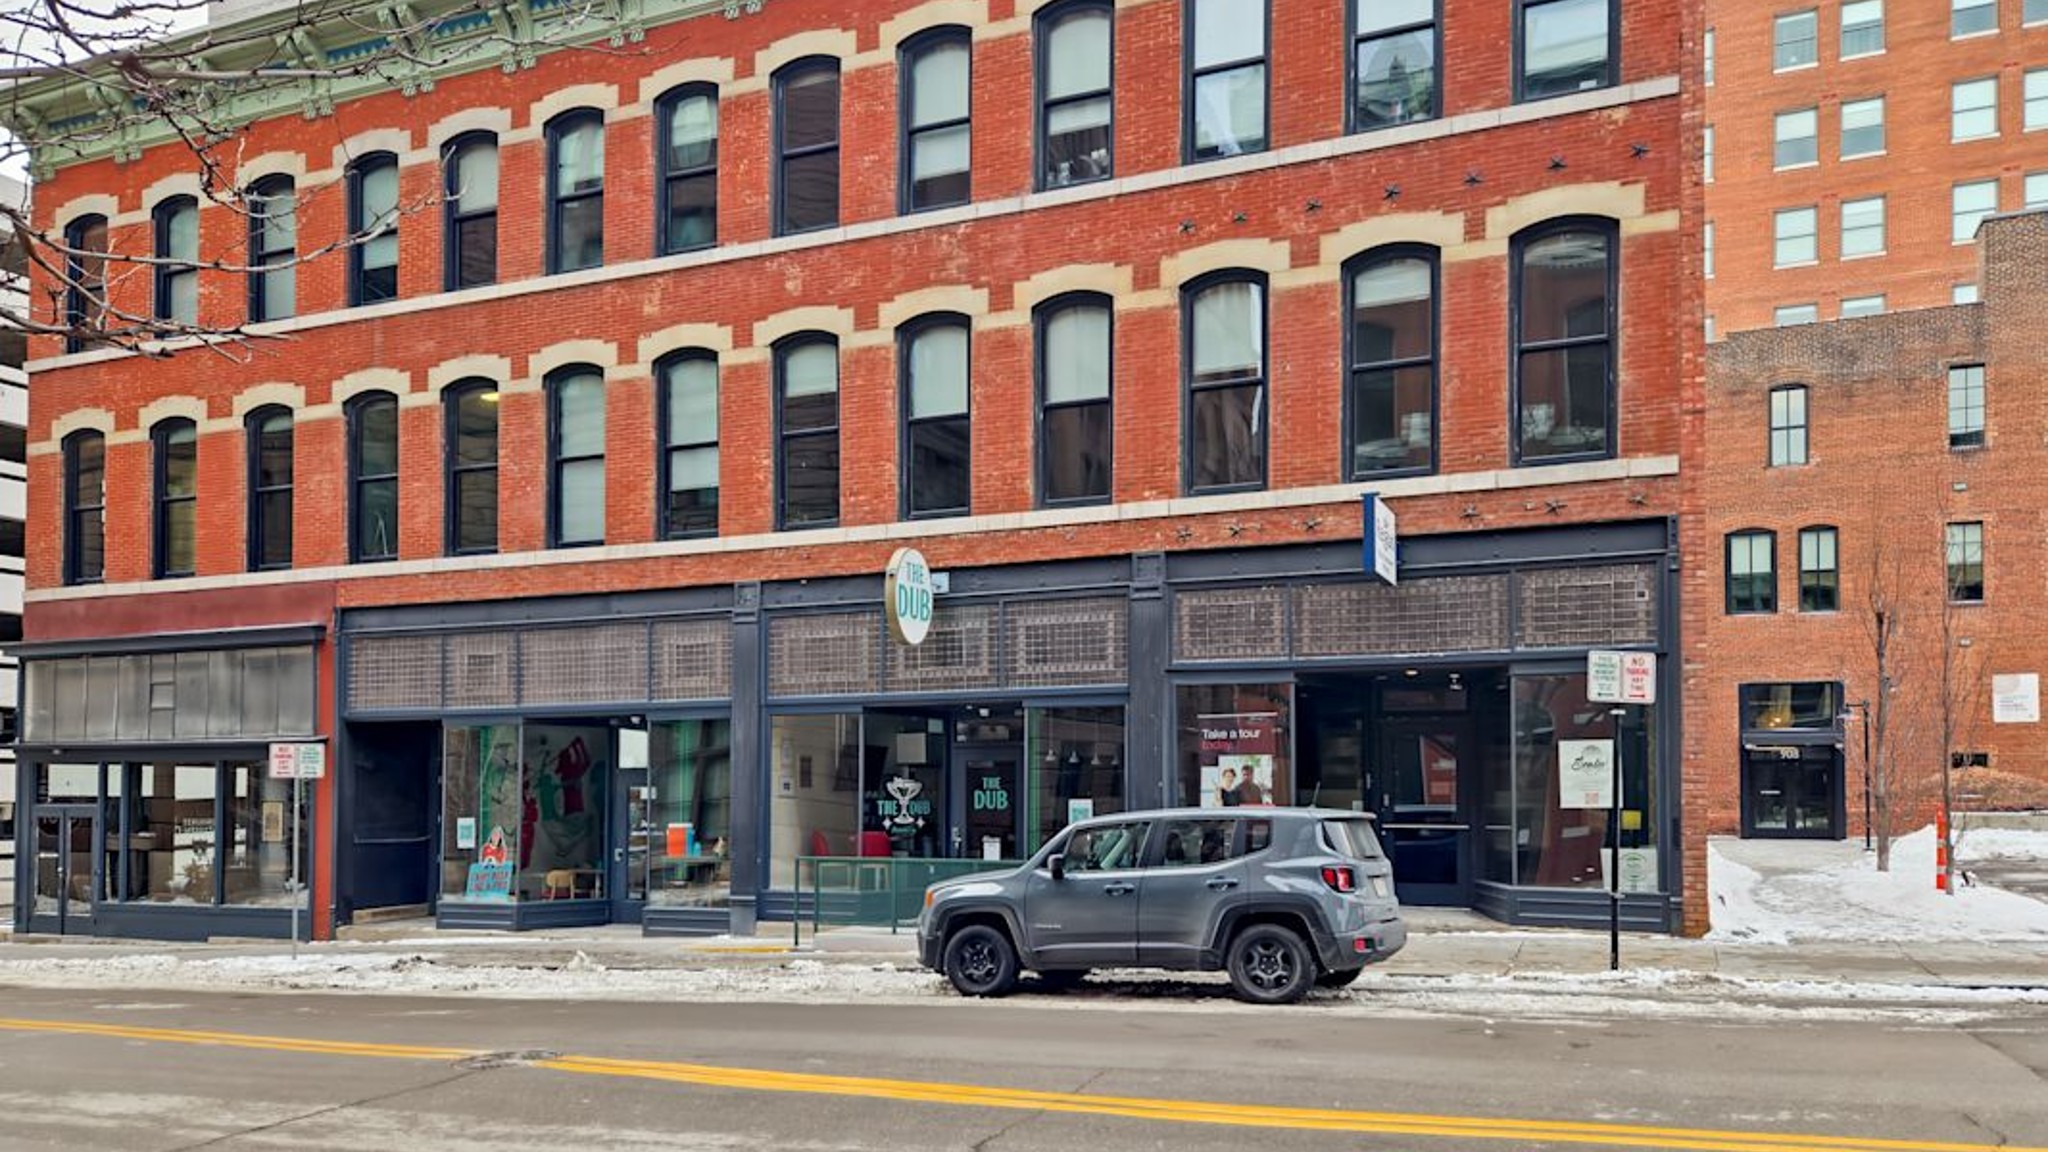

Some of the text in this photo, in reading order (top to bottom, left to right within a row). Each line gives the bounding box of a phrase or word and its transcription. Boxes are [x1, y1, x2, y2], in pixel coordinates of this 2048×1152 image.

[906, 562, 924, 584] THE
[899, 583, 930, 621] DUB
[1631, 656, 1645, 667] NO
[1202, 729, 1228, 739] Take
[1238, 729, 1261, 738] tour
[982, 777, 1001, 789] THE
[974, 790, 1008, 809] DUB
[877, 800, 898, 815] THE
